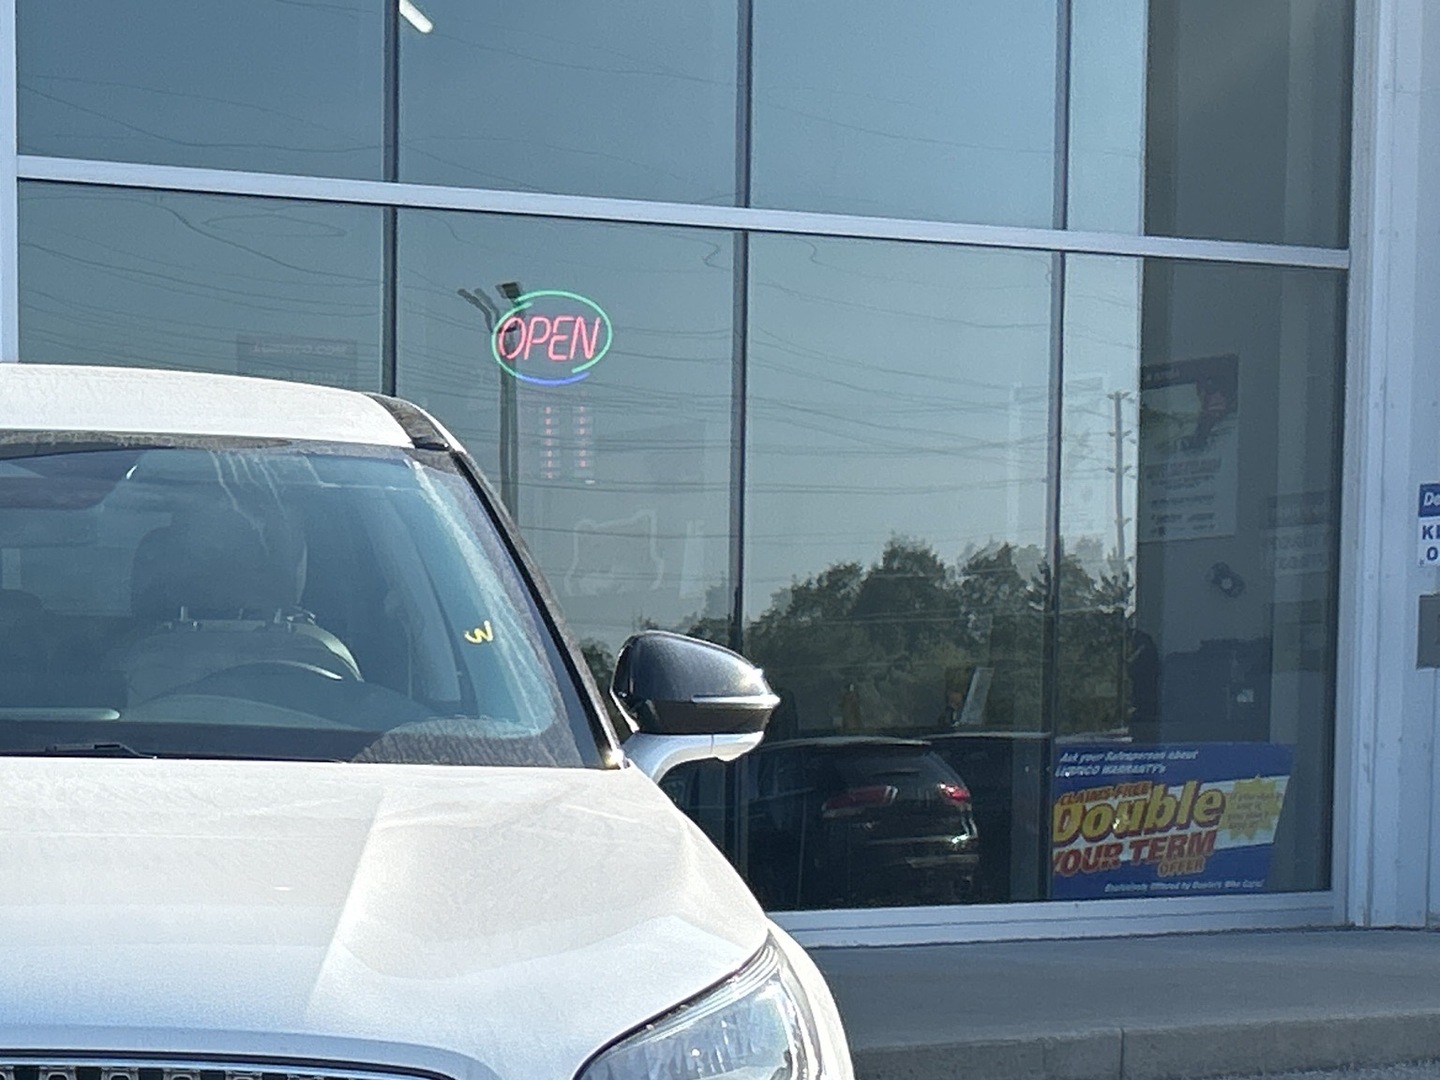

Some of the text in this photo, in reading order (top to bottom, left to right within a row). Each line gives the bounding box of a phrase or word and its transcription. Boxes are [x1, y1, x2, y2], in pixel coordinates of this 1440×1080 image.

[498, 315, 601, 361] OPEN
[1053, 780, 1226, 848] Double
[1129, 830, 1217, 865] TERM
